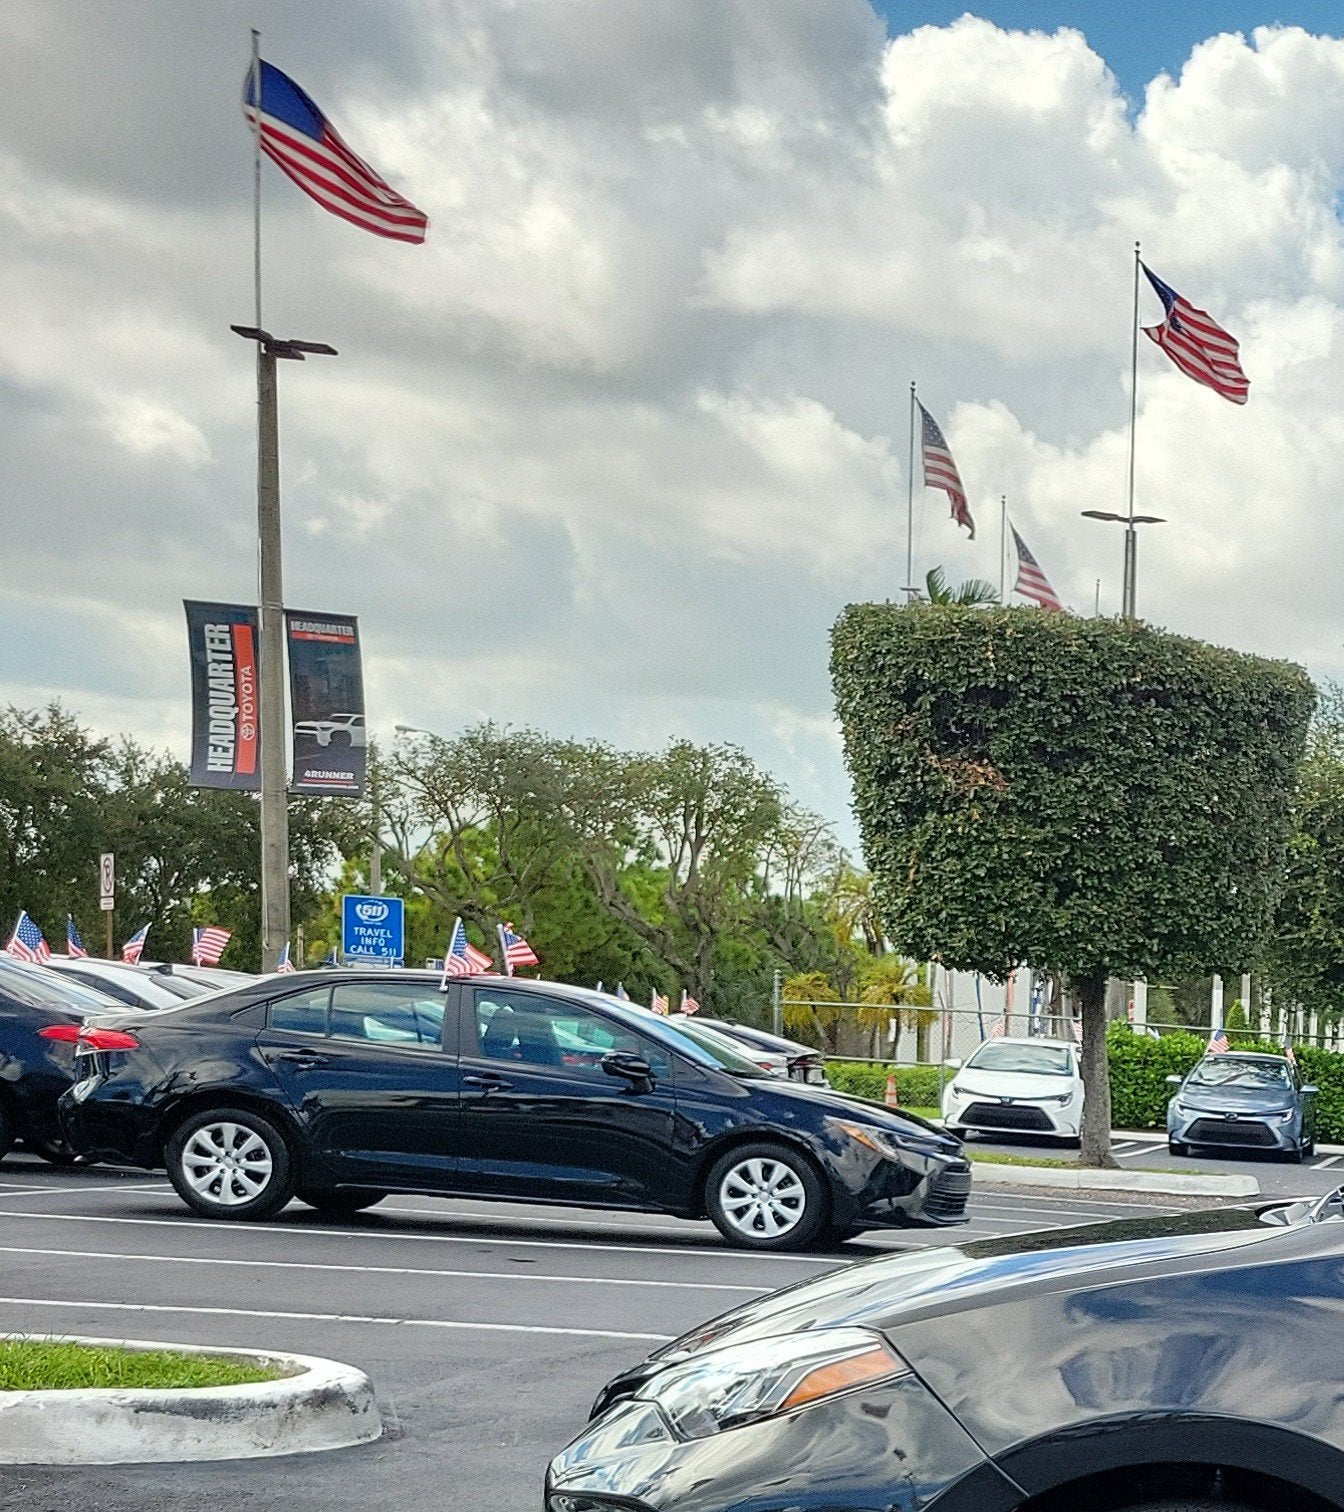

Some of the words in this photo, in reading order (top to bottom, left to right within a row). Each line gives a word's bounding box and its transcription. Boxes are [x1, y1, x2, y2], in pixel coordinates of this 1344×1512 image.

[205, 624, 239, 772] HEADQUARTER
[241, 665, 253, 721] TOYOTA
[304, 770, 354, 780] 4RUNNER
[354, 926, 393, 938] TRAVEL
[361, 937, 385, 947] INFO
[350, 945, 376, 955] CALL
[381, 948, 397, 957] 511
